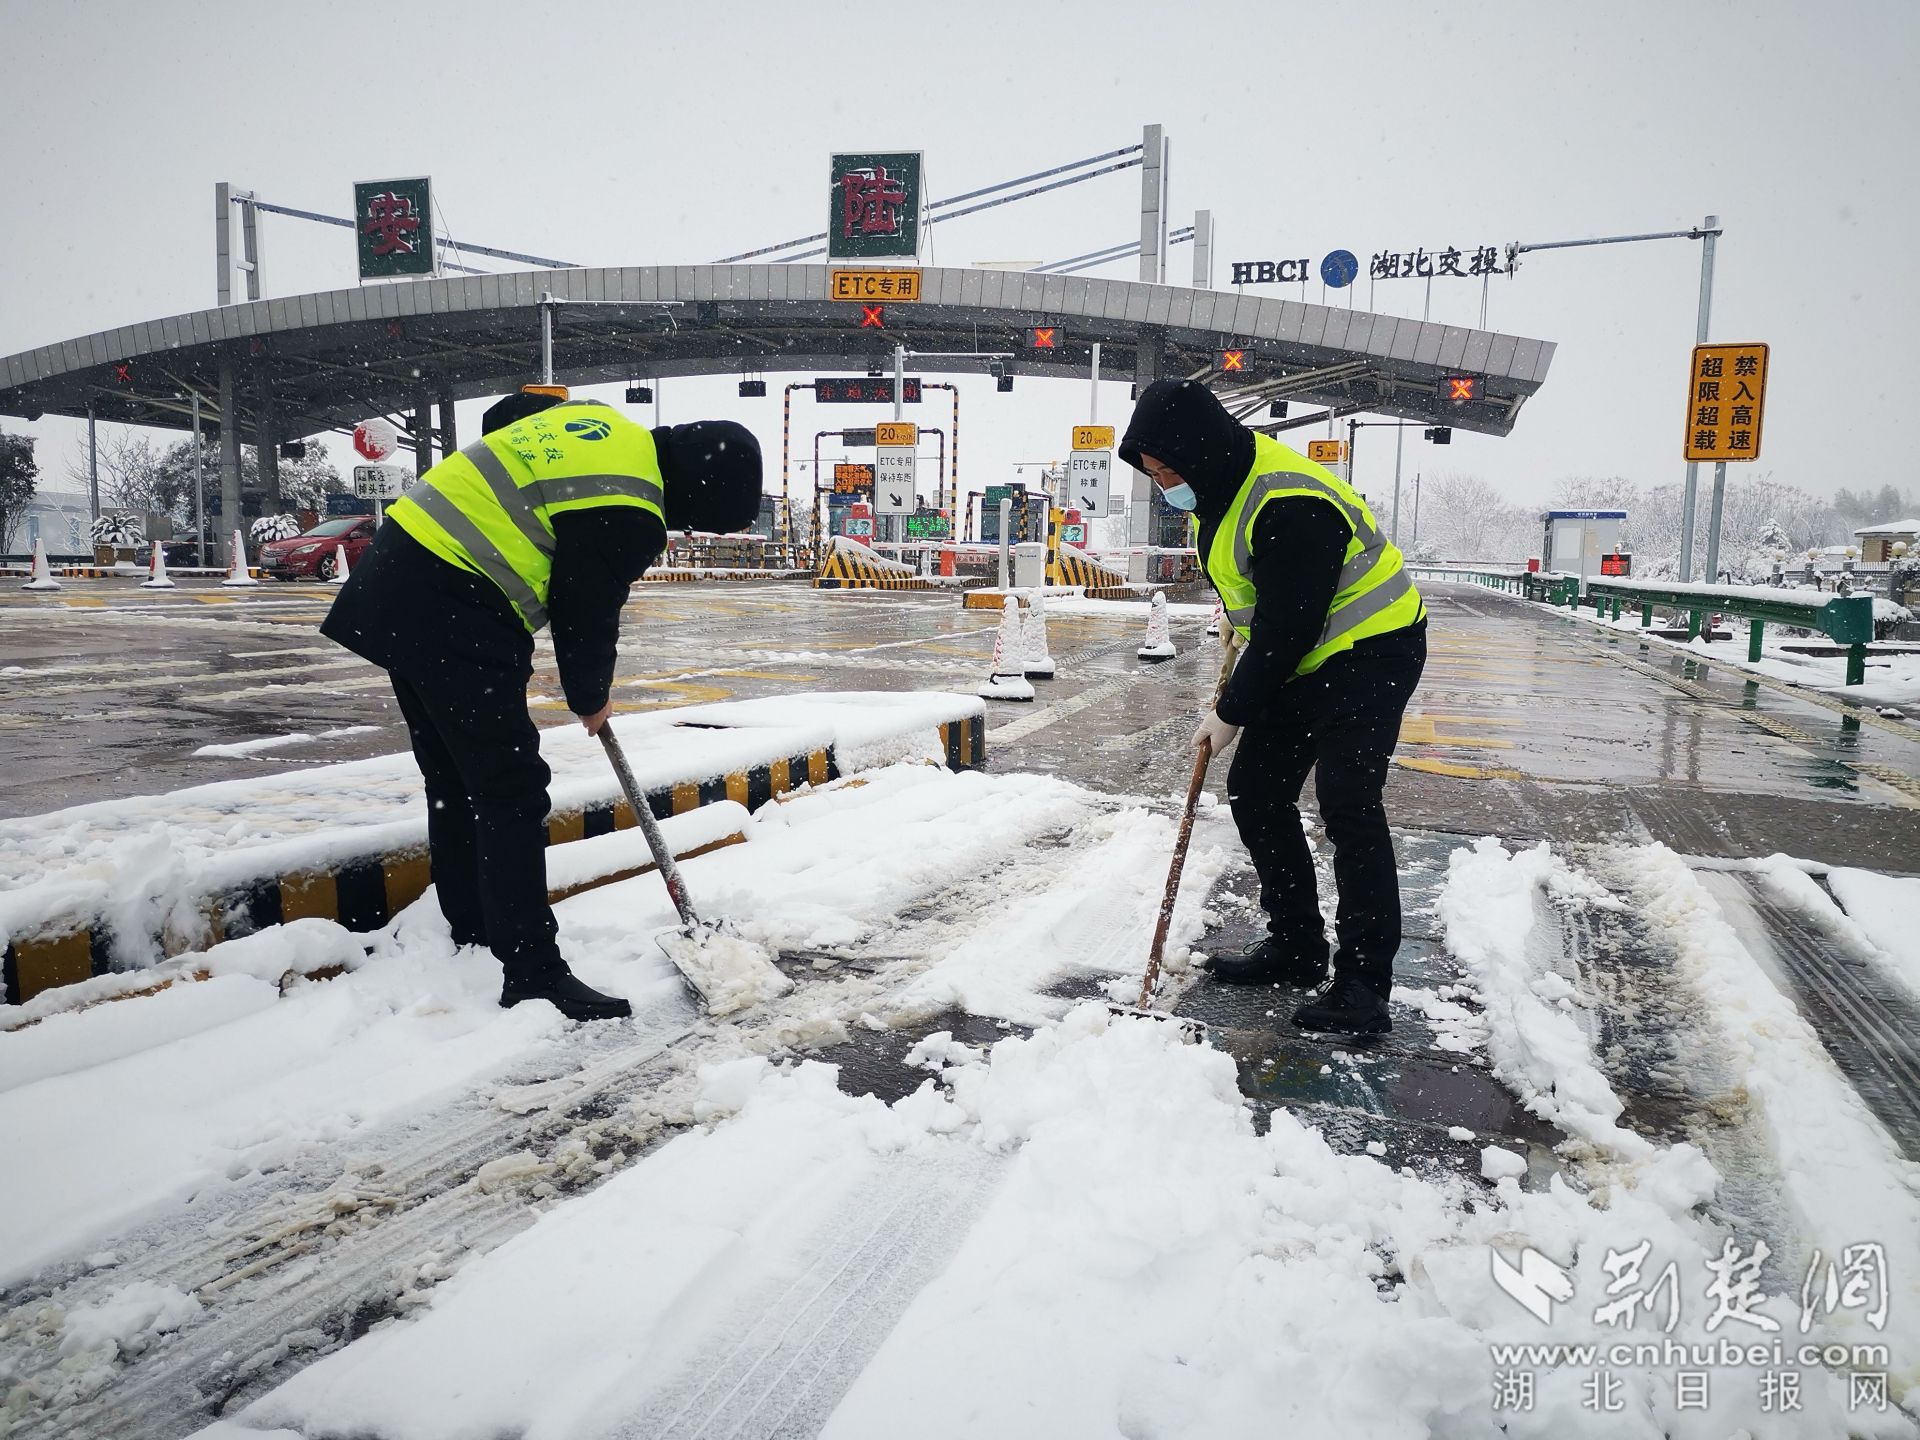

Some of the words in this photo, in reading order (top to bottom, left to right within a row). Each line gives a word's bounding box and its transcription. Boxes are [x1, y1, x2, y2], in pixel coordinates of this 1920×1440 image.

[841, 166, 907, 239] 陆
[364, 191, 420, 256] 安
[1231, 258, 1310, 285] HBCI
[1369, 245, 1504, 279] 湖北交投
[838, 276, 912, 295] ETC专用
[1694, 357, 1723, 451] 超限超载
[1727, 355, 1758, 450] 禁入高速
[880, 428, 896, 441] 20
[1080, 431, 1093, 445] 20
[1316, 445, 1324, 458] 5
[880, 457, 912, 467] ETC专用
[1073, 459, 1107, 471] ETC专用
[1080, 478, 1099, 488] 称重
